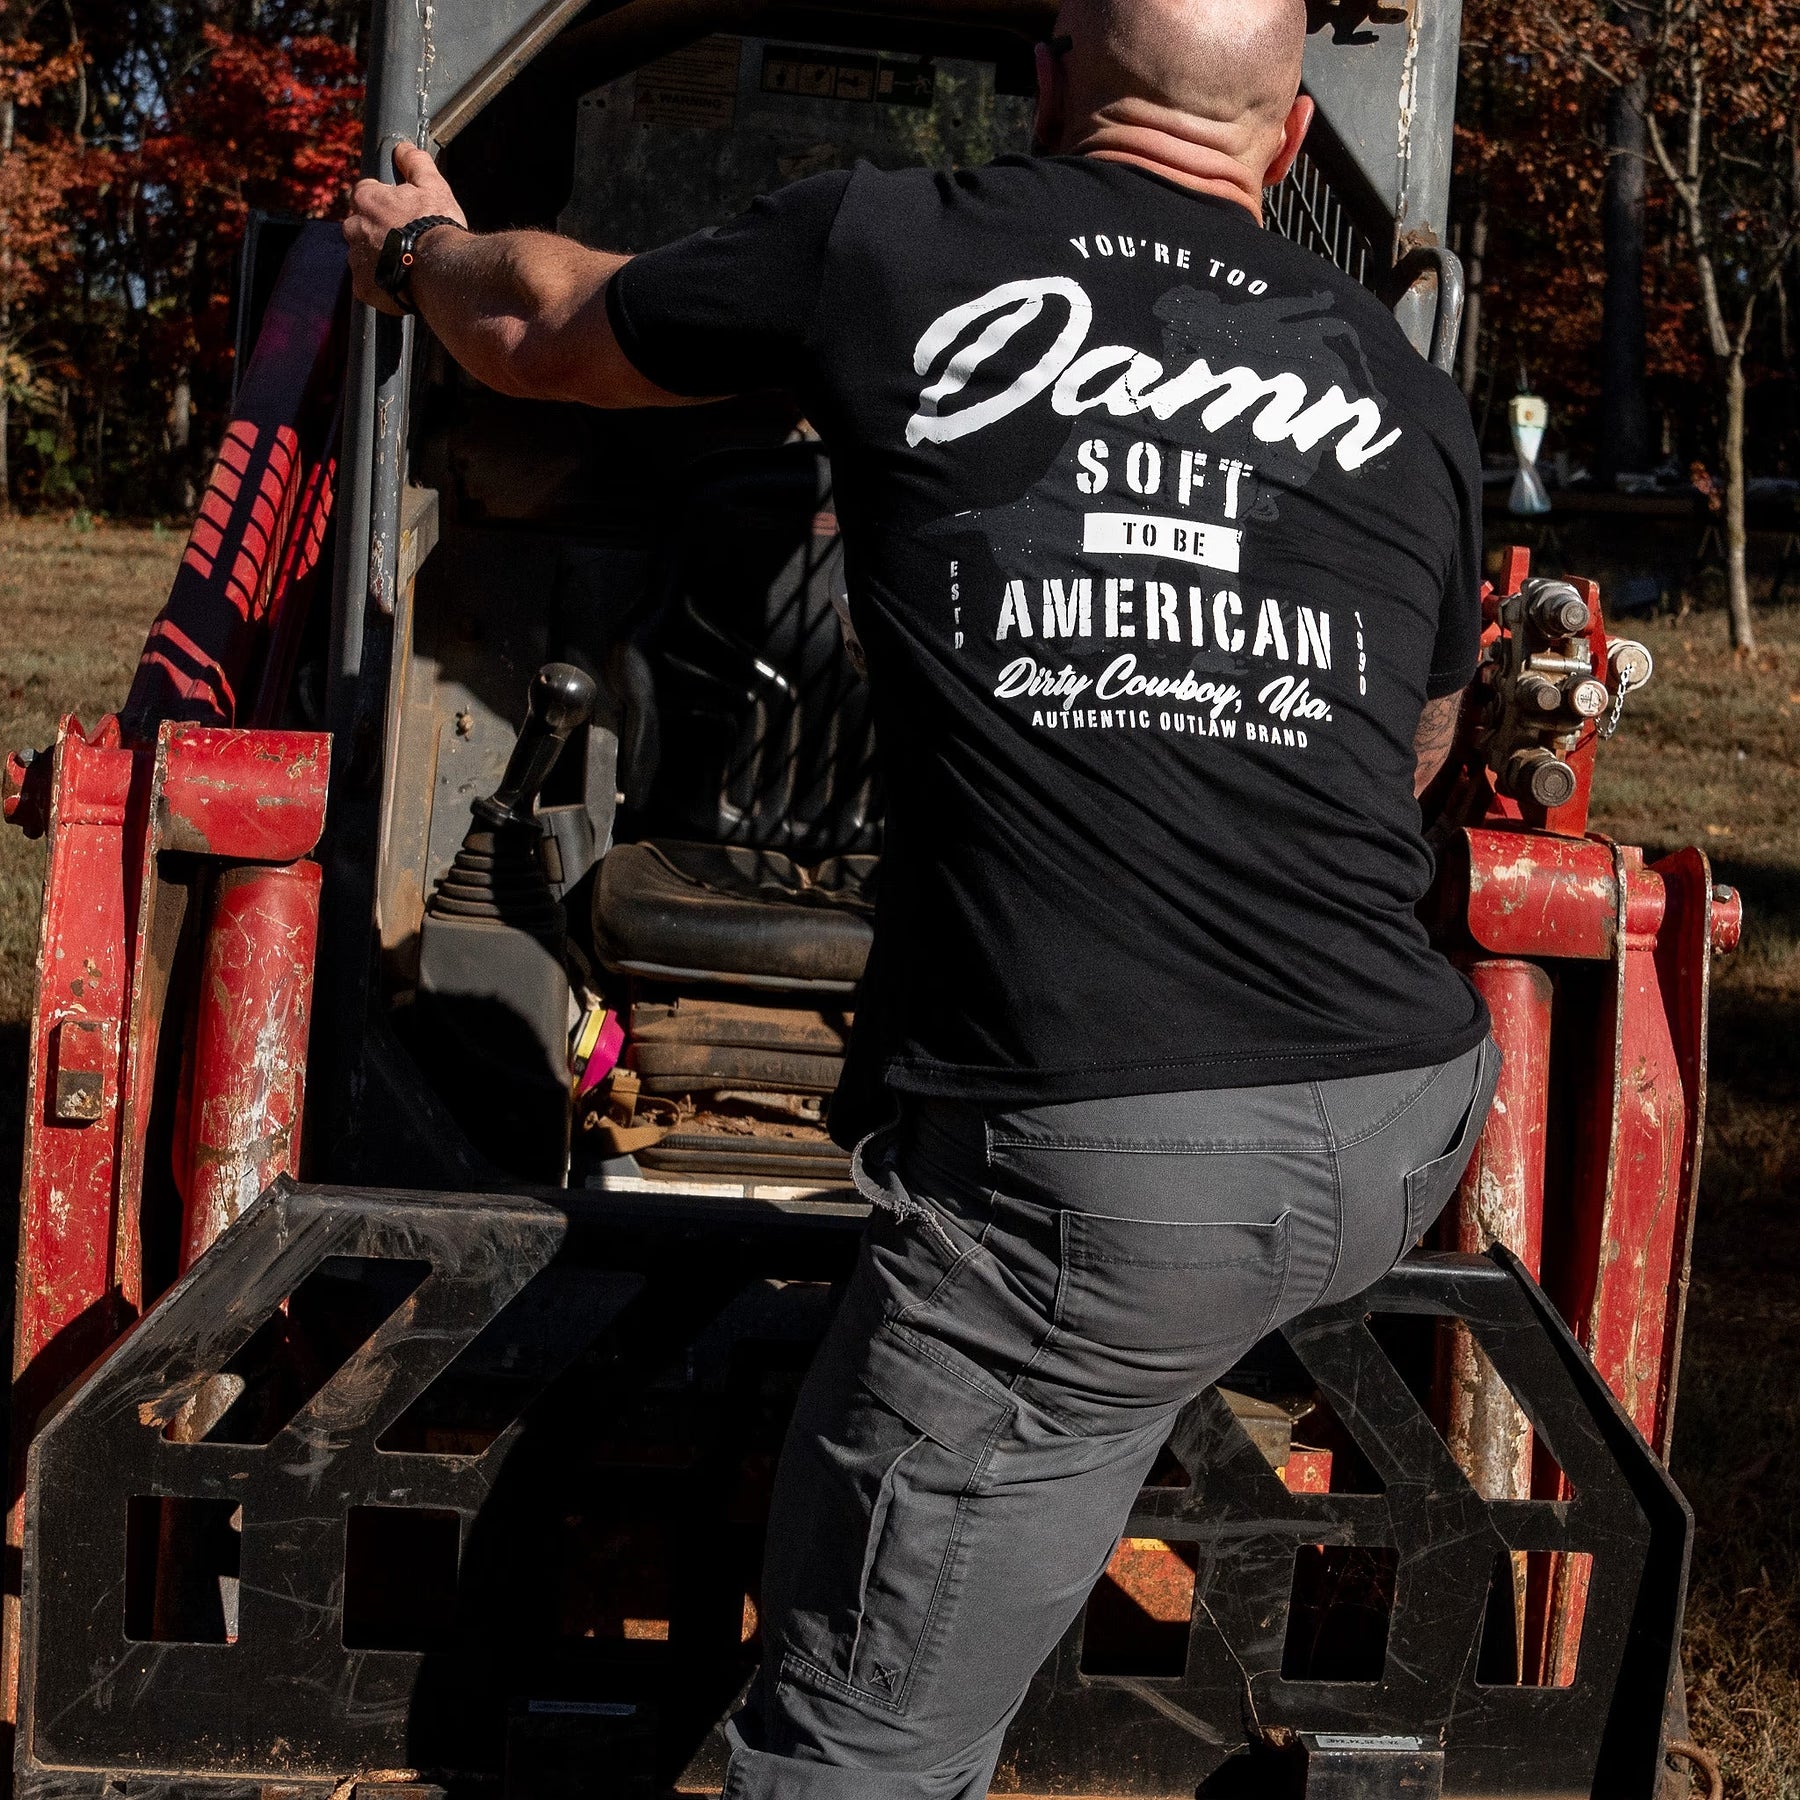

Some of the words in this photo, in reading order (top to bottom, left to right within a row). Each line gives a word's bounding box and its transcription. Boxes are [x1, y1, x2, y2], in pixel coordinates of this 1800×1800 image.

[660, 92, 722, 109] WARNING
[1069, 234, 1191, 269] YOU'RE
[1208, 258, 1268, 296] TOO
[904, 275, 1403, 472] Damn
[1076, 438, 1254, 519] SOFT
[1123, 522, 1157, 547] TO
[1173, 528, 1205, 557] BE
[950, 560, 964, 650] ESTD
[996, 578, 1332, 670] AMERICAN
[993, 656, 1093, 710] Dirty
[1095, 653, 1242, 719] Cowboy,
[1257, 675, 1333, 722] Usa.
[1354, 611, 1367, 696] 1990
[1031, 709, 1151, 730] AUTHENTIC
[1159, 712, 1237, 739] OUTLAW
[1245, 722, 1308, 748] BRAND
